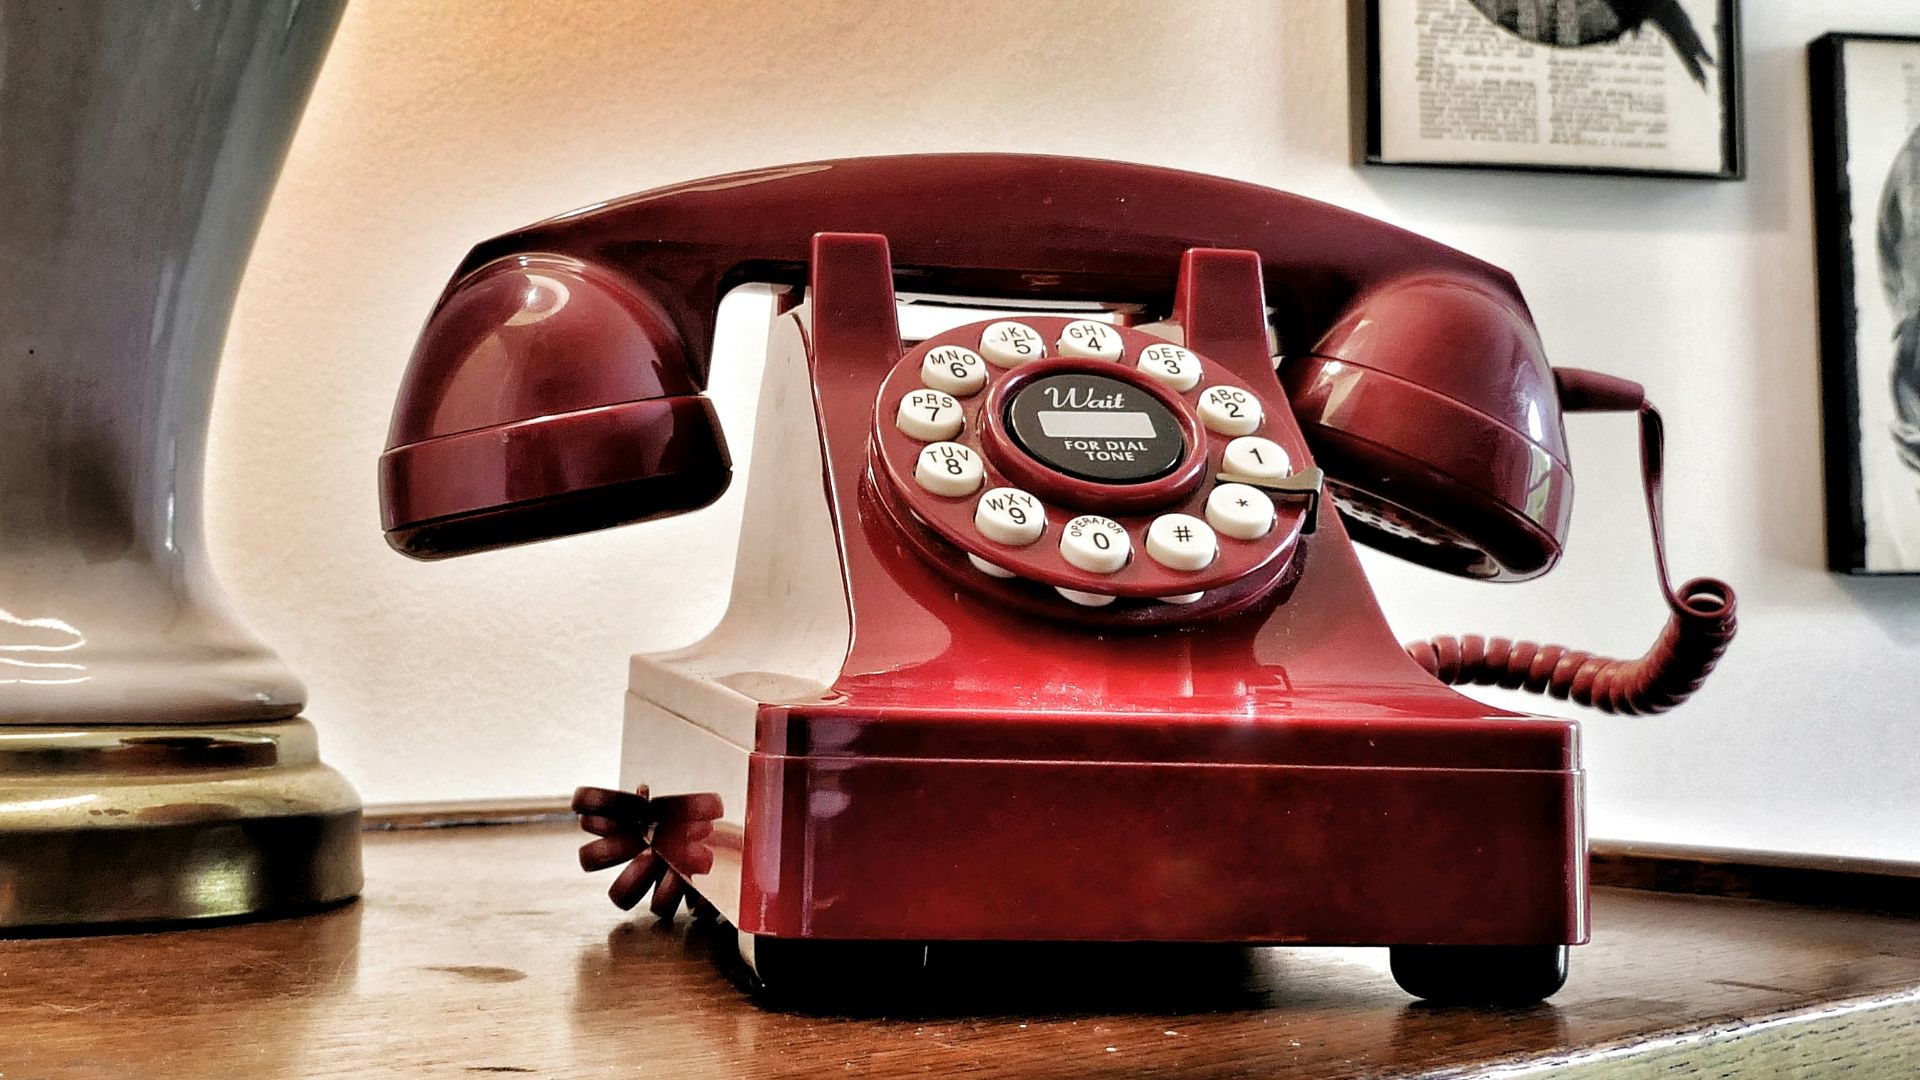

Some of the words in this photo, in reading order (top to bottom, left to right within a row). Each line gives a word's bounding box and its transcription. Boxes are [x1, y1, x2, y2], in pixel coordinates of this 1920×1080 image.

[1000, 326, 1035, 342] JKL
[1070, 325, 1106, 339] GHI
[1014, 339, 1031, 354] 5
[1088, 336, 1101, 352] 4
[930, 349, 975, 366] MNO
[1148, 348, 1185, 362] DEF
[950, 362, 966, 378] 6
[1165, 360, 1181, 374] 3
[912, 393, 952, 408] PRS
[1043, 387, 1125, 409] Wait
[1209, 389, 1246, 405] ABC
[924, 406, 939, 421] 7
[1224, 403, 1243, 418] 2
[1064, 440, 1099, 451] FOR
[1102, 441, 1148, 451] DIAL
[926, 445, 969, 463] TUV
[1085, 451, 1135, 461] TONE
[1249, 448, 1264, 464] 1
[945, 458, 962, 475] 8
[986, 493, 1034, 511] WXY
[1009, 507, 1026, 525] 9
[1070, 517, 1125, 537] OPERATOR
[1174, 525, 1193, 542] #
[1093, 532, 1110, 550] 0
